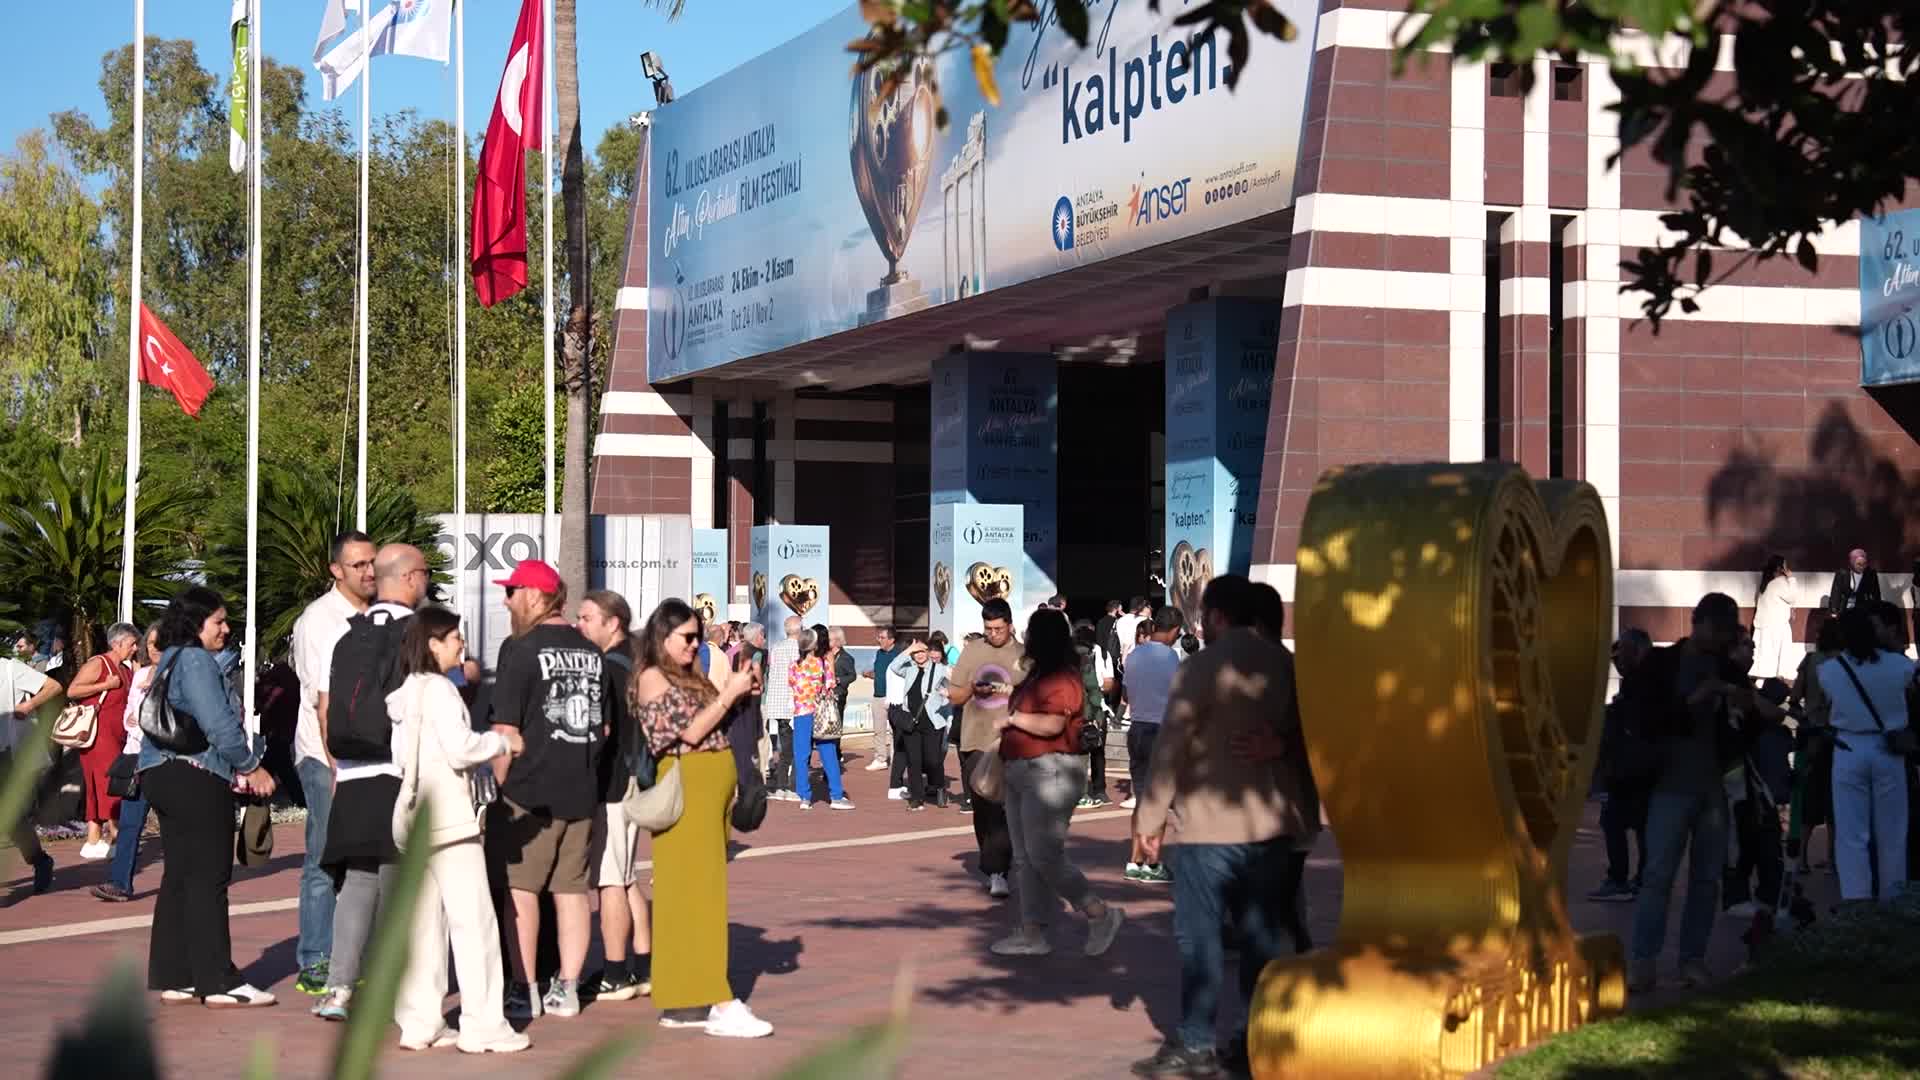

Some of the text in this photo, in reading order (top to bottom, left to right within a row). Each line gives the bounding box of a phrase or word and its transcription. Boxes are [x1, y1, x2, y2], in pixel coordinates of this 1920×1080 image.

[664, 123, 775, 198] 62. ULUSLARARASI ANTALYA
[740, 176, 760, 213] FİLM
[761, 152, 802, 205] FESTİVALİ
[1076, 189, 1104, 208] ANTALYA
[1884, 229, 1908, 262] 62.
[732, 270, 741, 294] 24
[741, 266, 759, 291] Ekim
[765, 260, 770, 283] 2
[771, 257, 794, 281] Kasım
[688, 297, 723, 328] ANTALYA
[769, 296, 774, 321] 2
